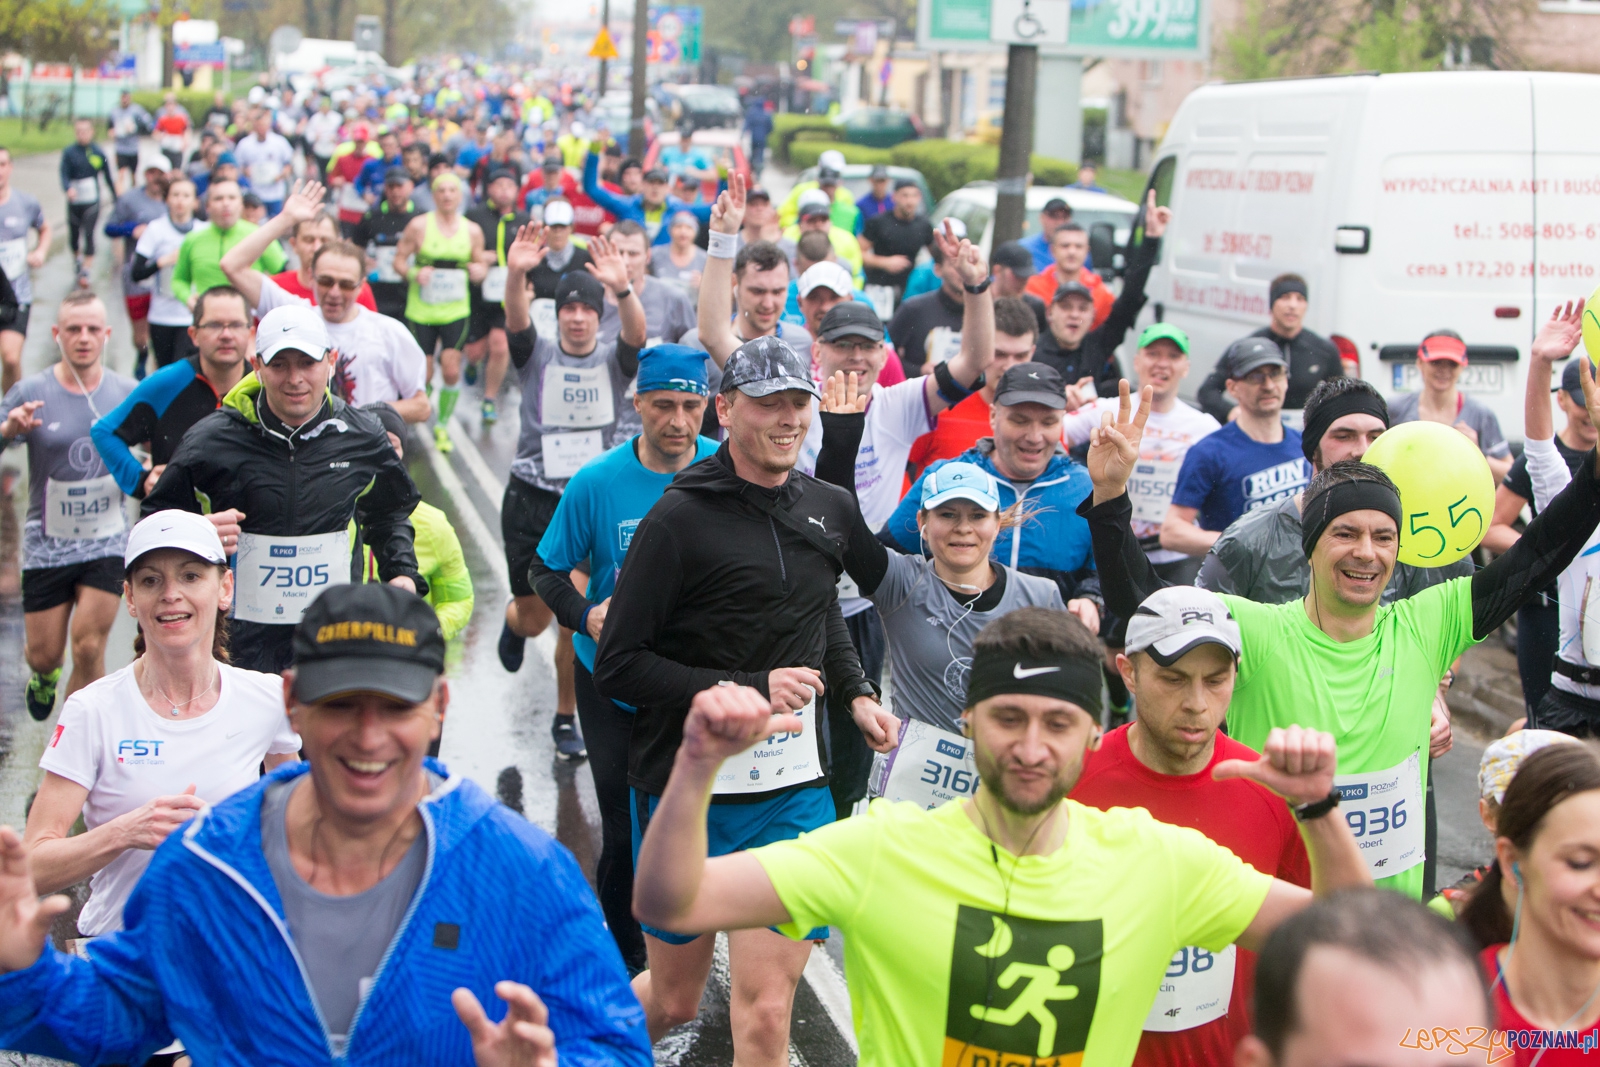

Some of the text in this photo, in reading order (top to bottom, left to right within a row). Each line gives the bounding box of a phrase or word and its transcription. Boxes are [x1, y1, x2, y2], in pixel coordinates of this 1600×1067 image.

[1519, 179, 1548, 194] AUT
[1406, 262, 1447, 277] cena
[1540, 261, 1594, 277] brutto
[563, 387, 599, 403] 6911
[1250, 457, 1306, 497] RUN
[60, 496, 110, 517] 11343
[259, 563, 329, 588] 7305
[282, 590, 308, 599] Maciej
[118, 739, 165, 757] FST
[753, 748, 784, 759] Mariusz
[126, 757, 165, 766] Sport Team
[1356, 838, 1384, 850] obert
